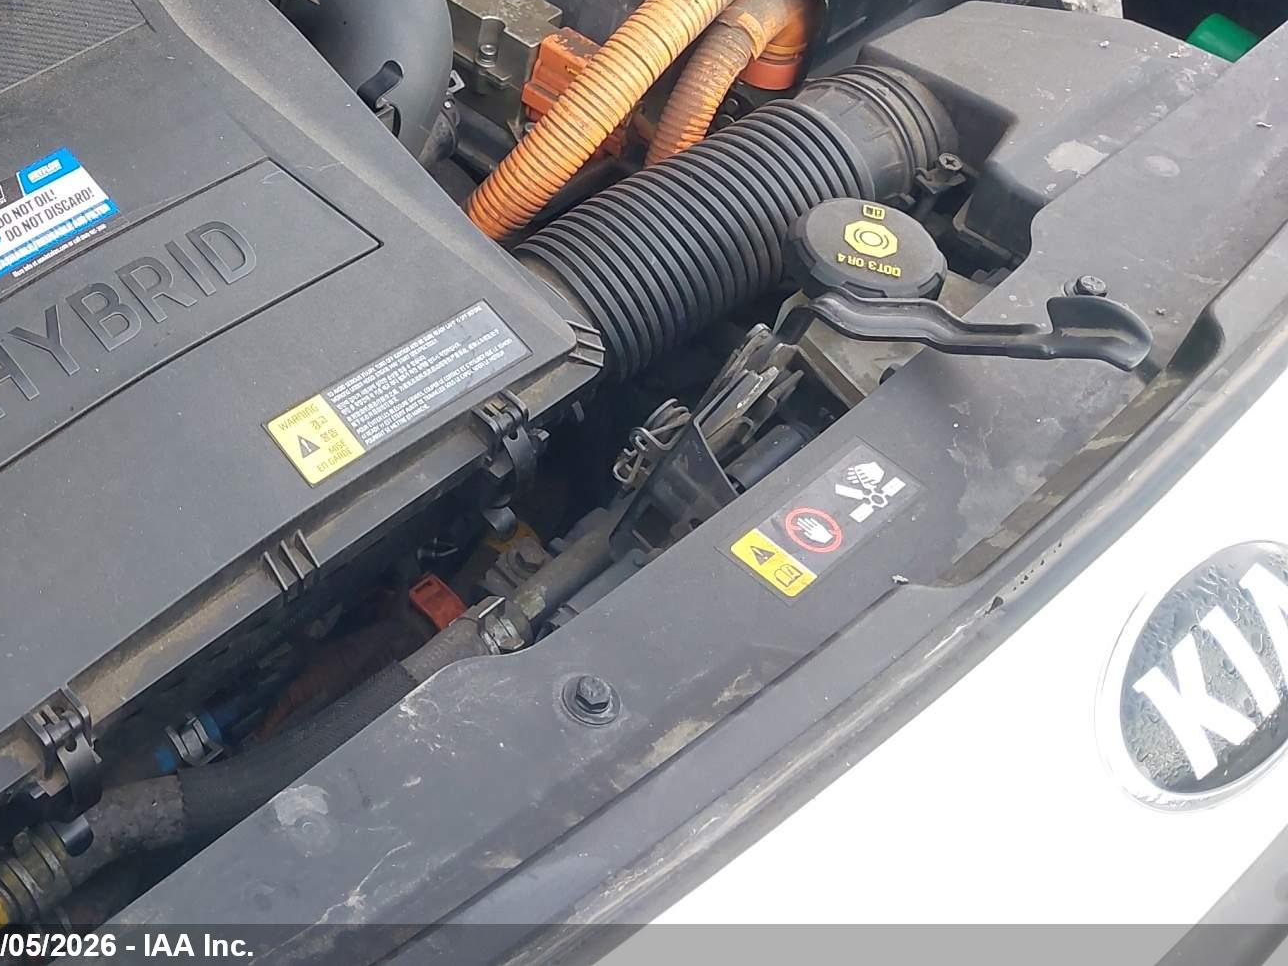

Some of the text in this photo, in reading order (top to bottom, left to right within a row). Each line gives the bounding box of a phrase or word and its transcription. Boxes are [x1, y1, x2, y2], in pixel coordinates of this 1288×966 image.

[5, 186, 95, 242] DO NOT DISCARD!
[12, 200, 34, 220] NOT
[34, 189, 57, 207] OIL!
[837, 253, 846, 262] 4
[848, 256, 865, 267] OR
[278, 403, 319, 431] WARNING
[328, 439, 346, 455] MISE
[330, 447, 353, 466] GARDE
